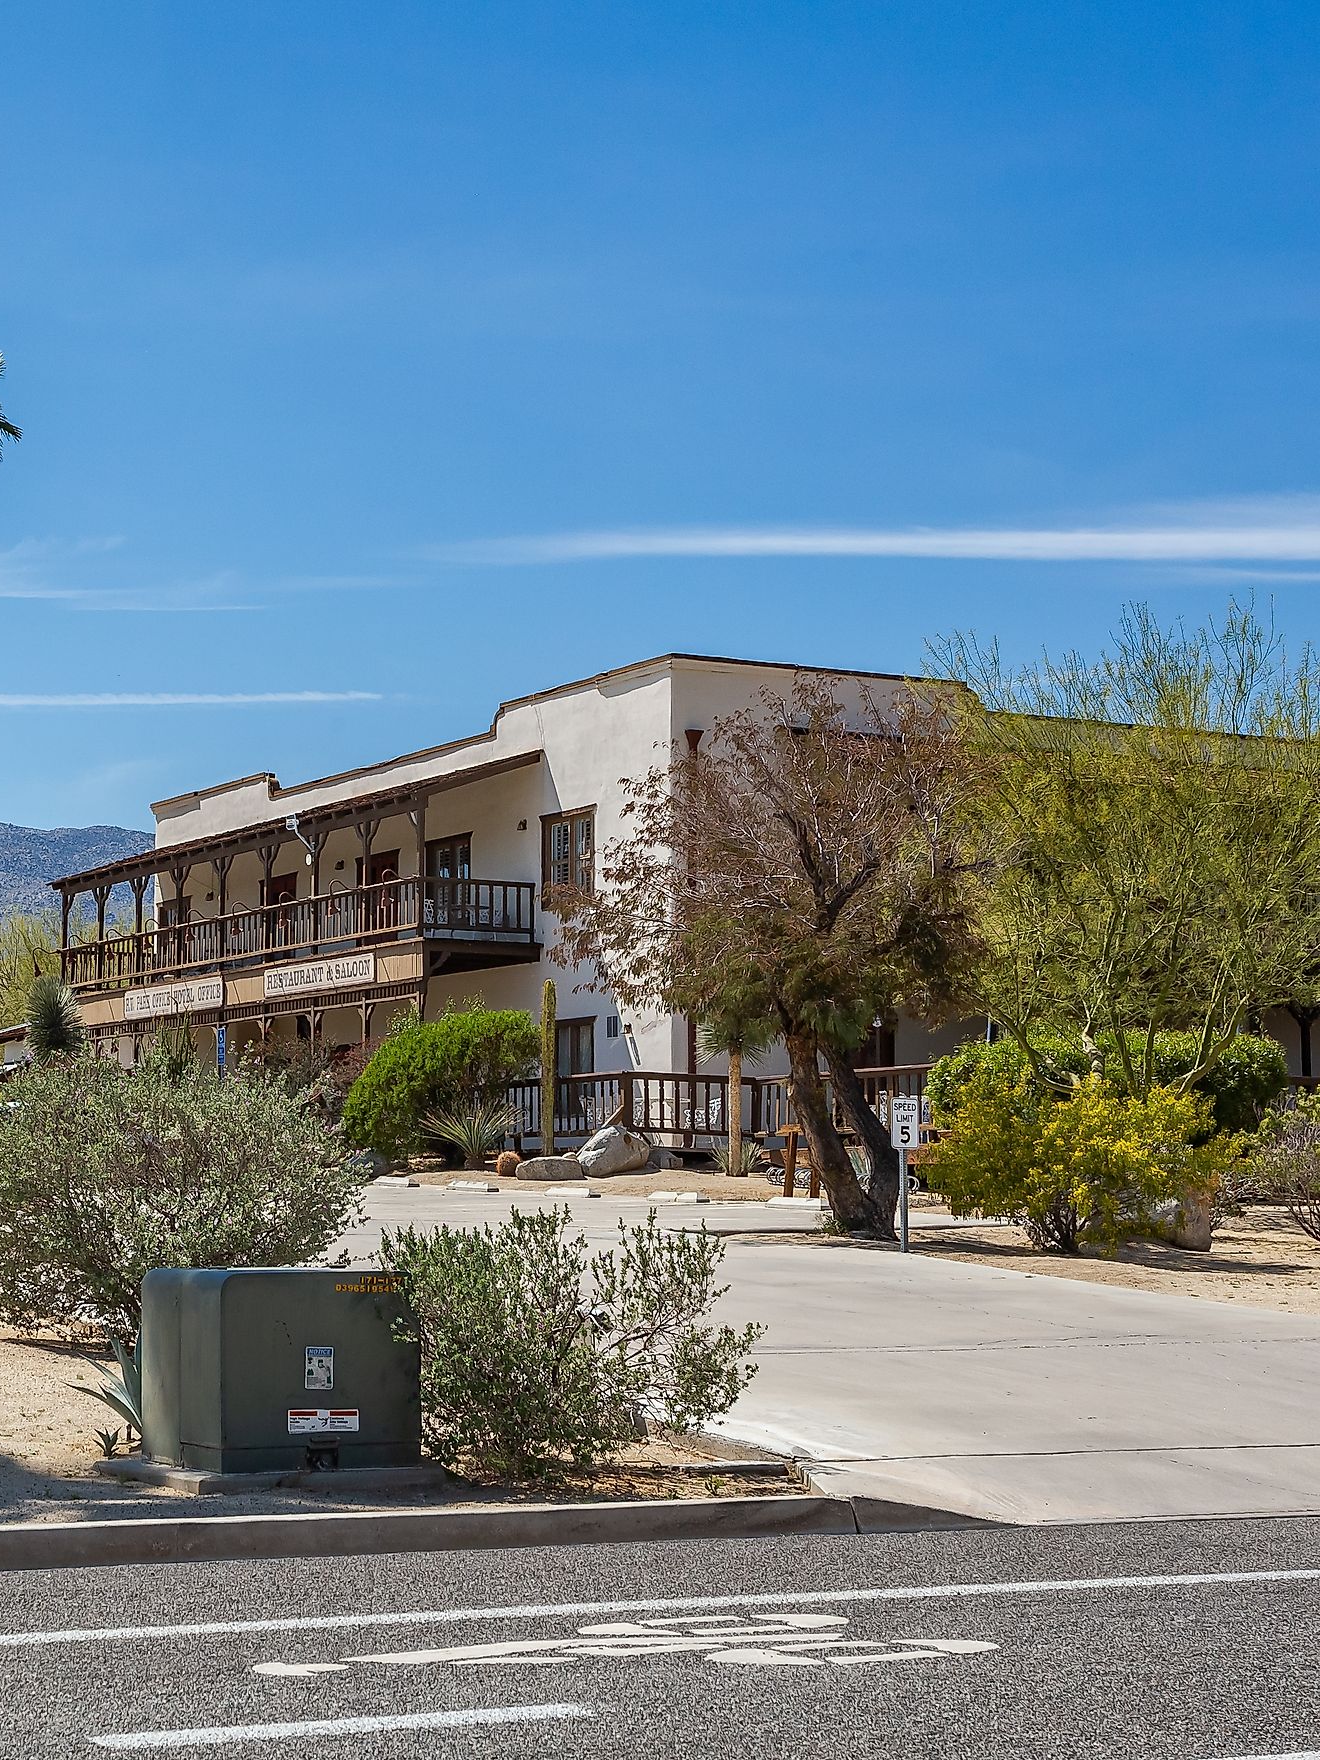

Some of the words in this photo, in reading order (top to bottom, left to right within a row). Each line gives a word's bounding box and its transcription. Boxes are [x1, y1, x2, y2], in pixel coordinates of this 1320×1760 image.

[266, 966, 324, 991] RESTAURANT
[326, 964, 334, 981] &
[335, 959, 371, 980] SALOON
[197, 983, 221, 1002] OFFICE
[893, 1102, 916, 1112] SPEED
[896, 1114, 914, 1123] LIMIT
[900, 1125, 911, 1144] 5
[308, 1348, 332, 1356] NOTICE
